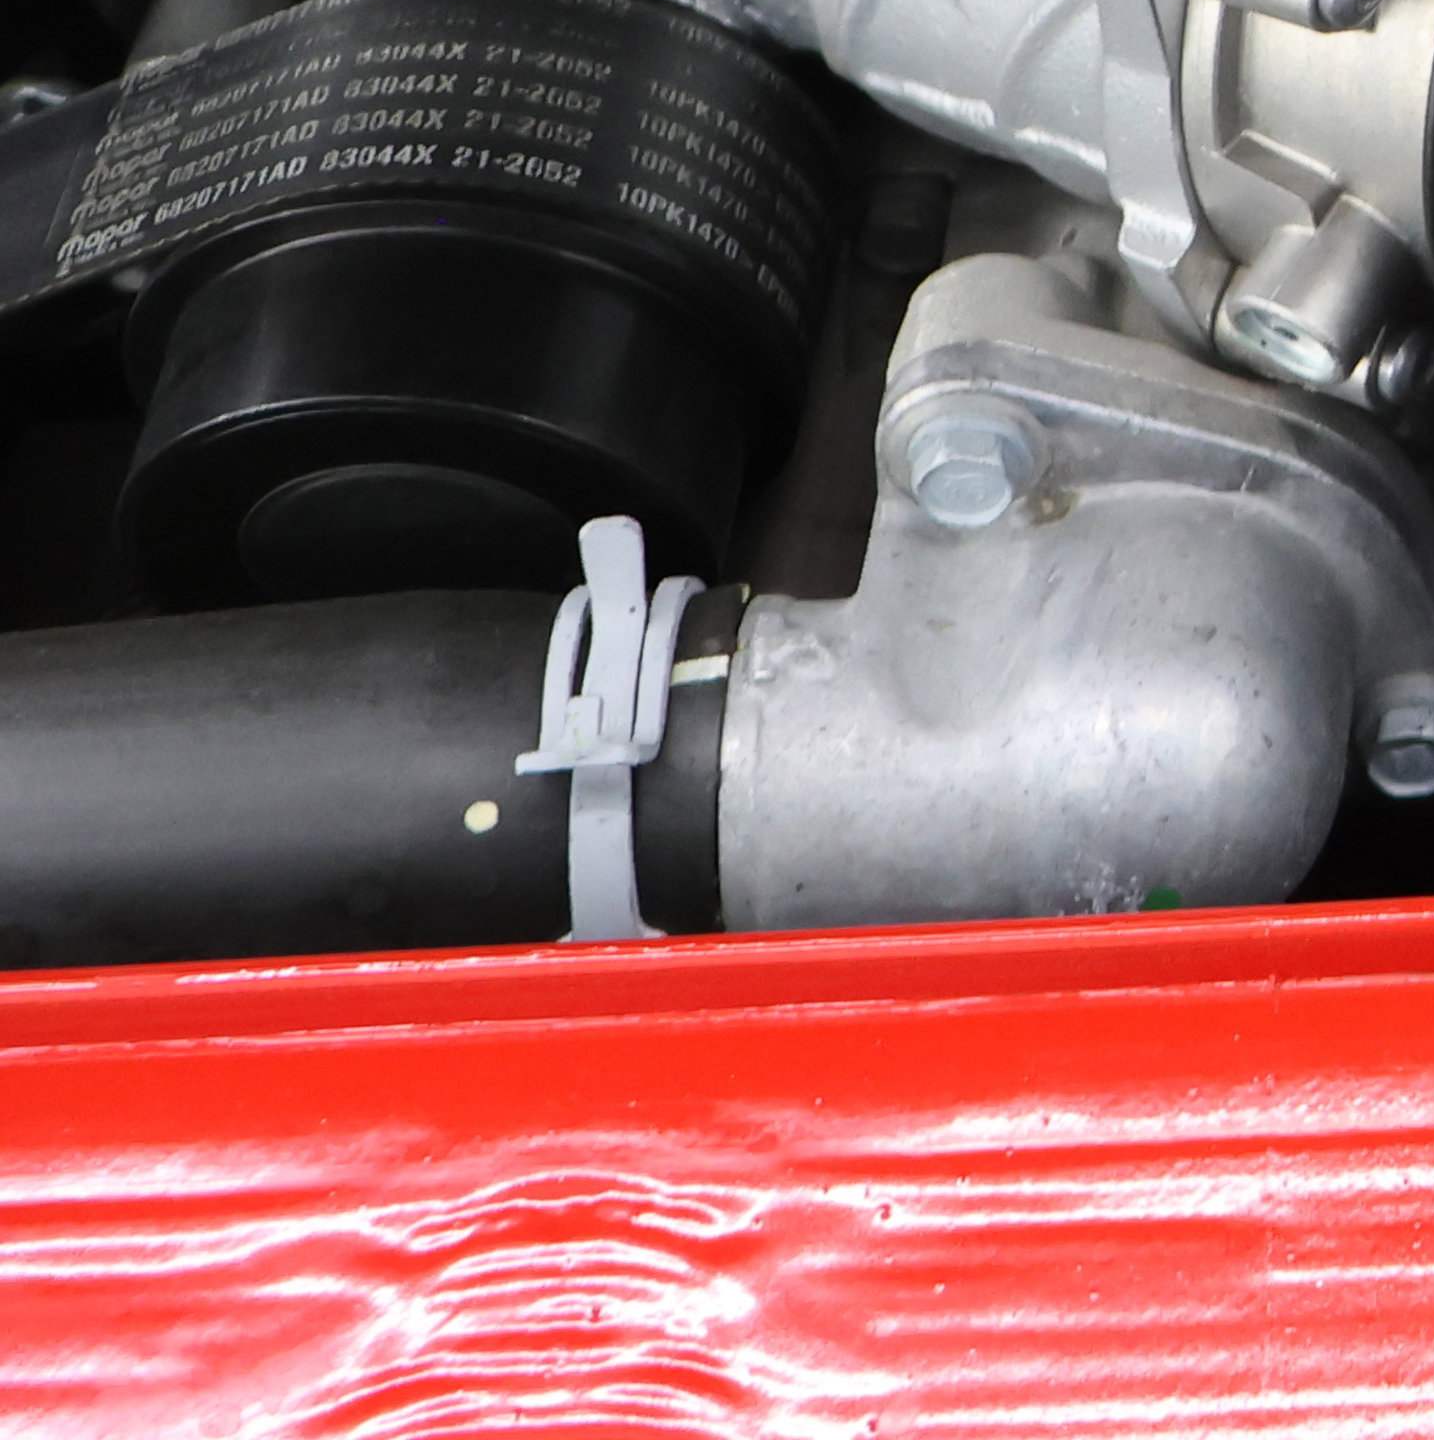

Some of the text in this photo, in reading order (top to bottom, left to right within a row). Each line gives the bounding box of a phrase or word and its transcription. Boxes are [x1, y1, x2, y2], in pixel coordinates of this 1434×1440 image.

[57, 212, 149, 274] mopar
[154, 154, 308, 225] 68207171AD
[319, 143, 439, 172] 83044X
[617, 181, 741, 260] 10PK1470
[70, 177, 161, 236] mopar
[331, 108, 448, 135] 83044X
[81, 142, 173, 196] mopar
